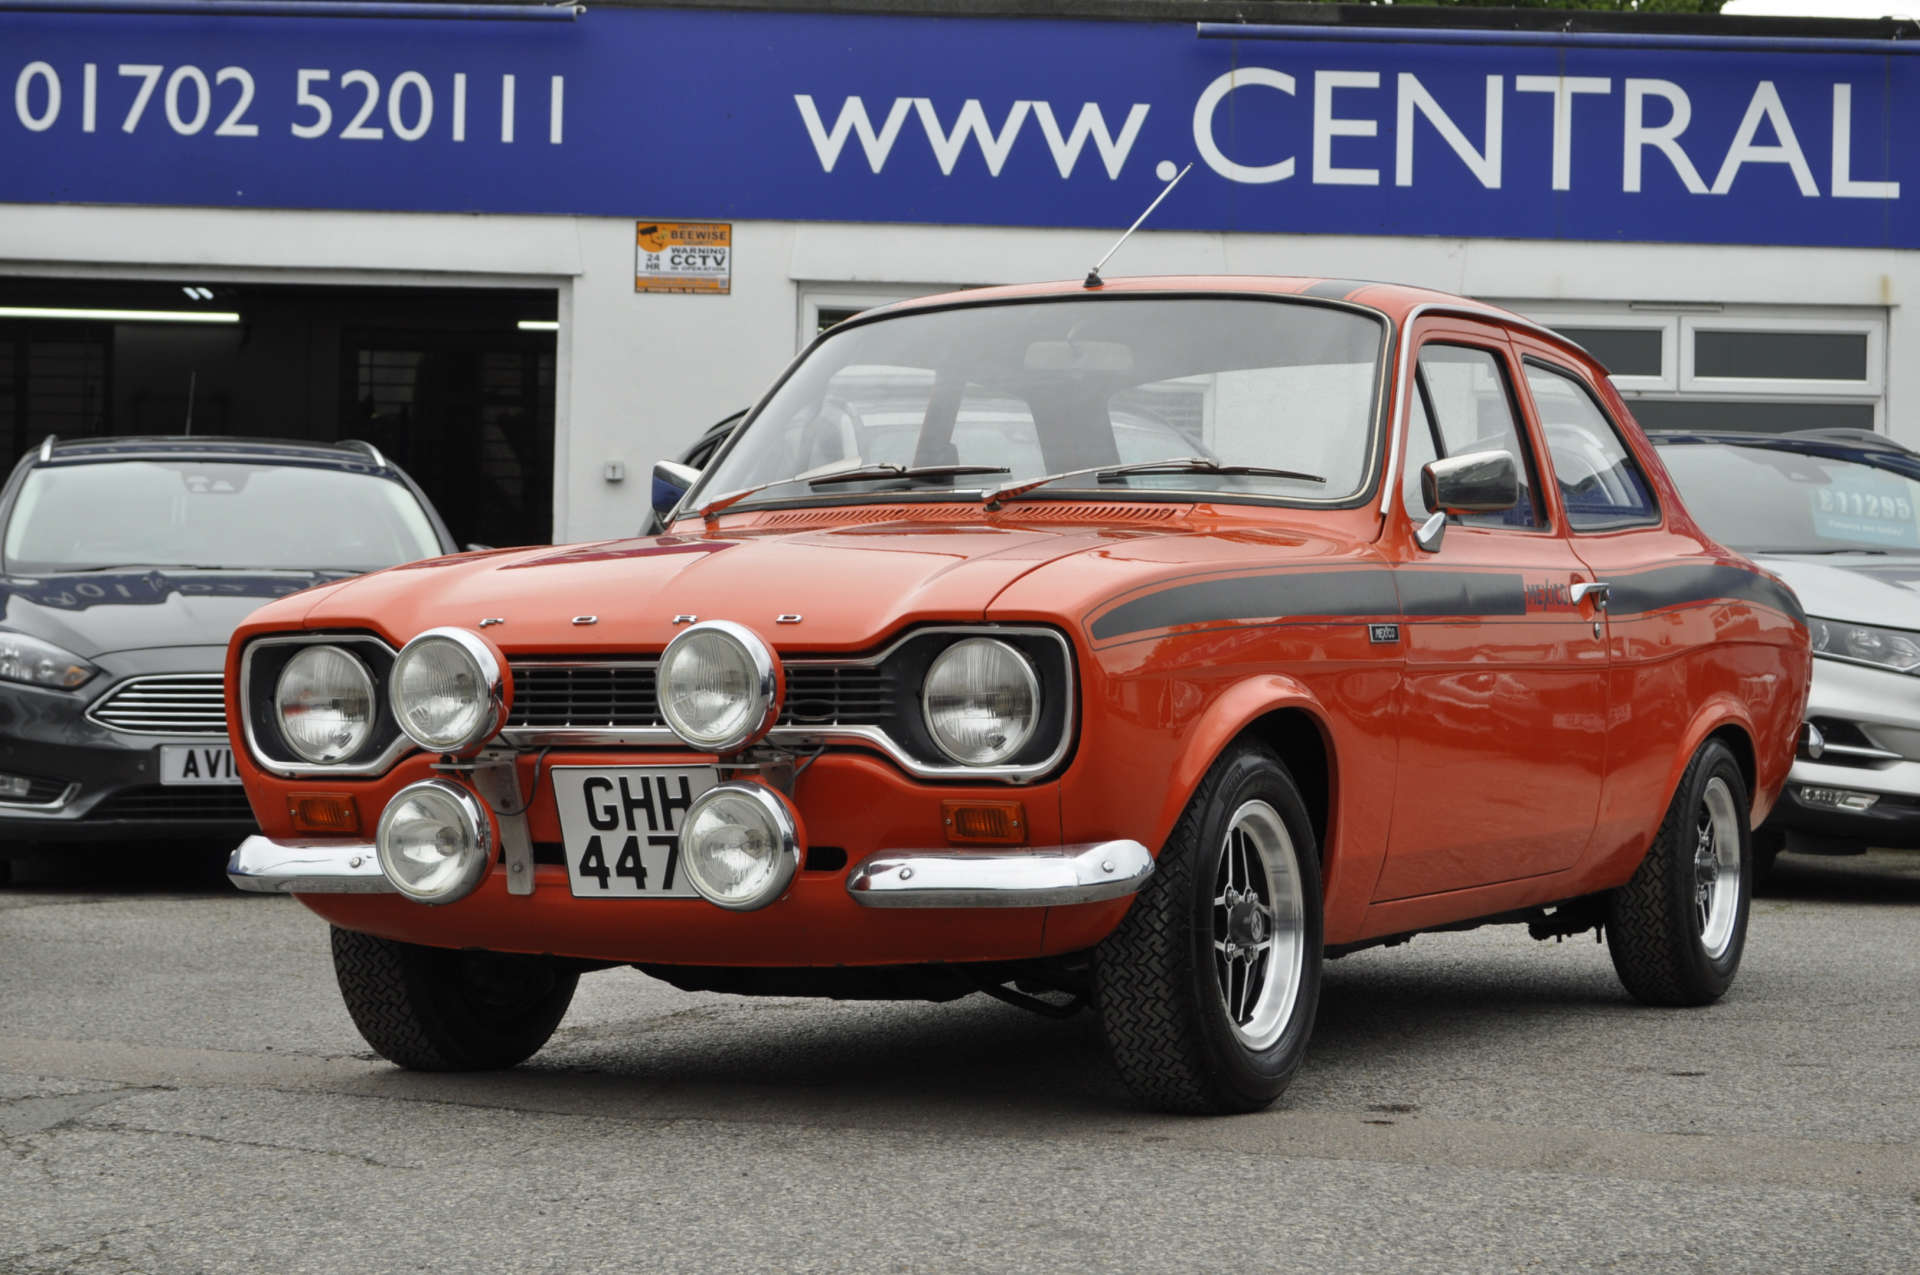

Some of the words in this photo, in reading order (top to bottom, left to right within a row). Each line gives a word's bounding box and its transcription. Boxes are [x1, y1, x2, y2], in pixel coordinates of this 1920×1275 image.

[15, 61, 259, 136] 01702
[291, 69, 564, 144] 520111
[671, 230, 727, 240] BEEWISE
[671, 247, 726, 255] WARNING
[670, 255, 726, 266] CCTV
[582, 775, 692, 832] GHH
[578, 835, 682, 890] 447
